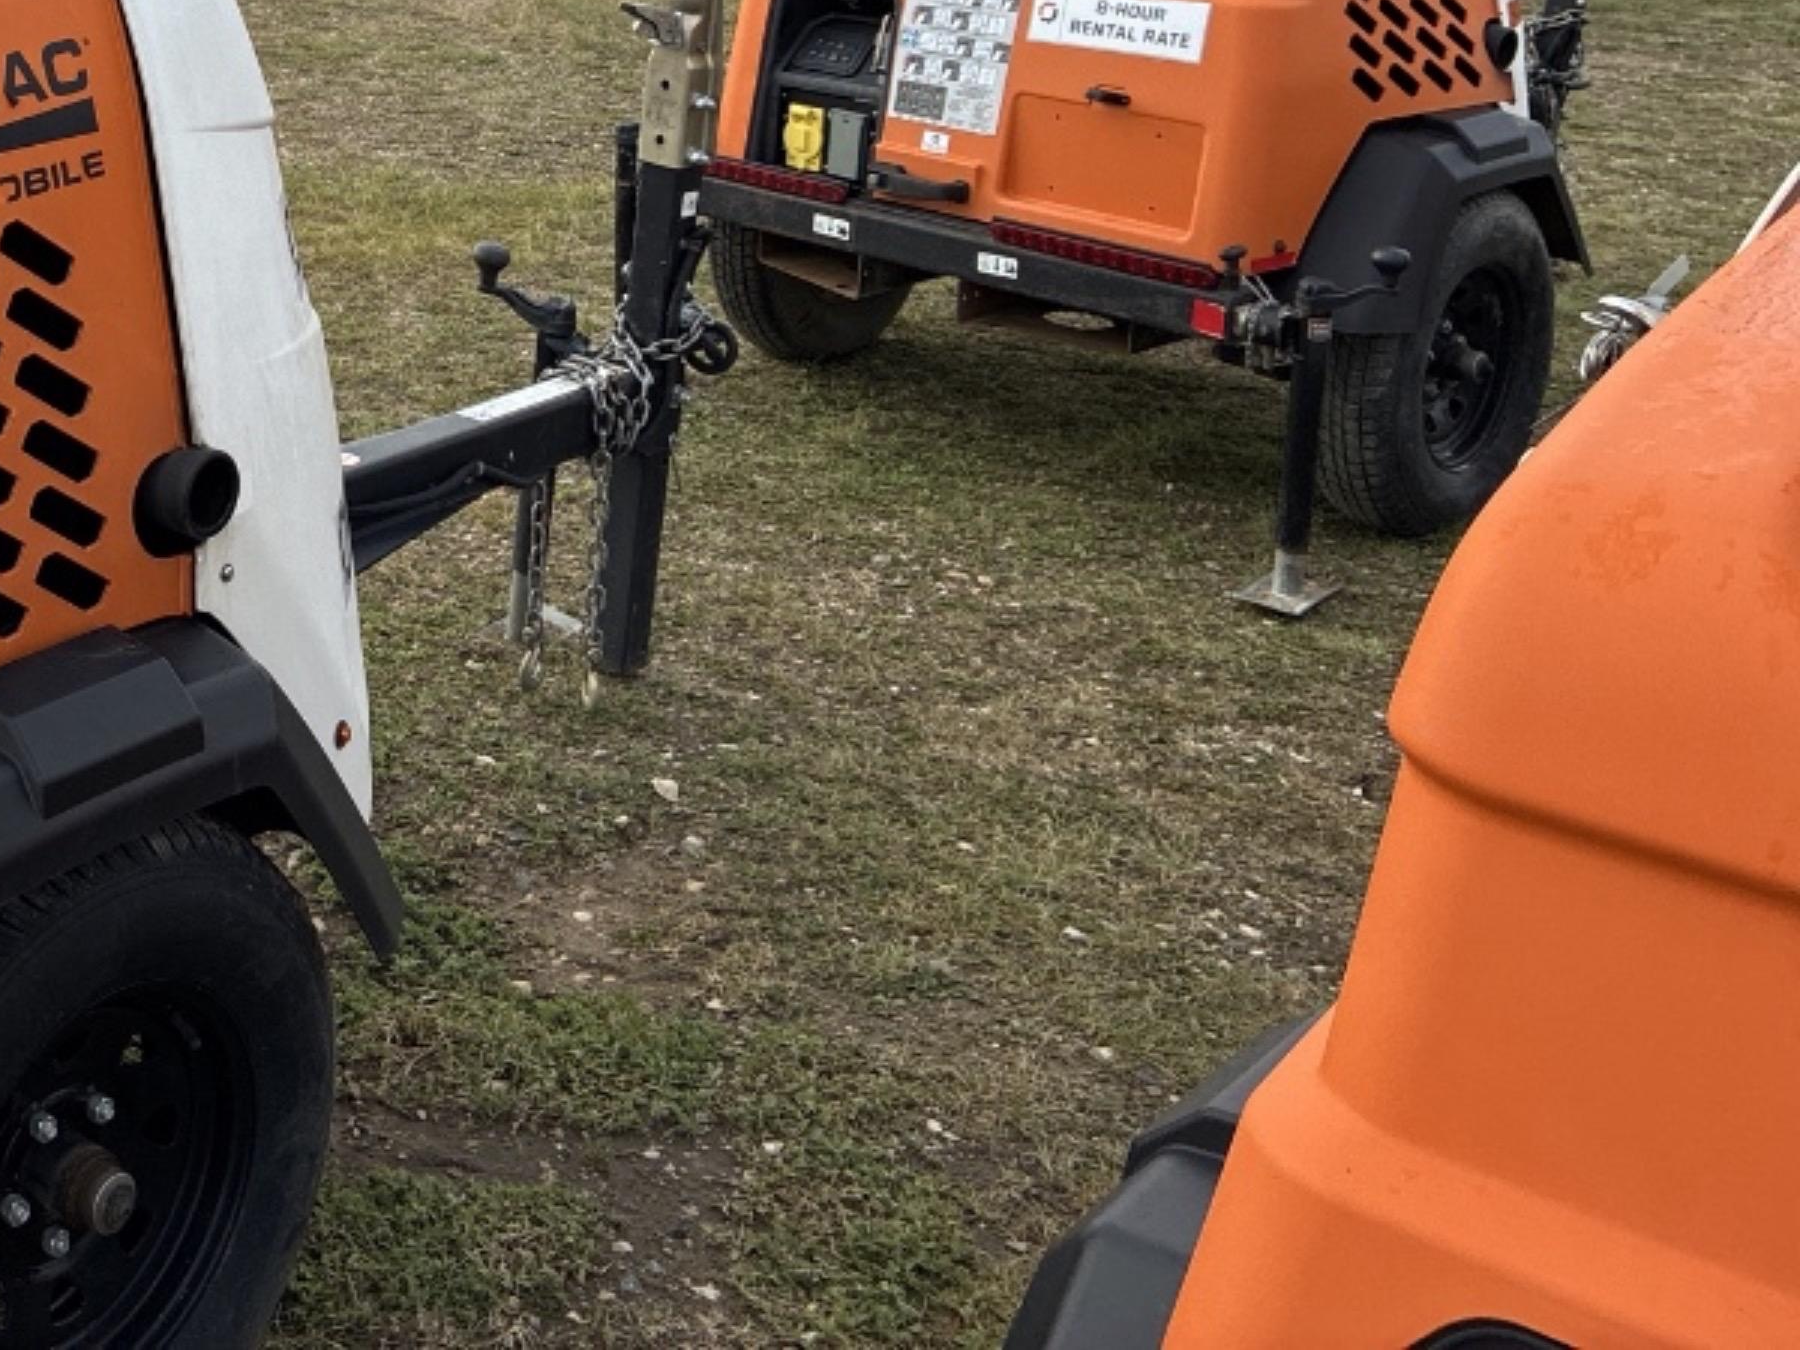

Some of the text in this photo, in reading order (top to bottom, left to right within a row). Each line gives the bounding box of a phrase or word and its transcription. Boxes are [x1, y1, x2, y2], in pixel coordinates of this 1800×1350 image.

[1095, 0, 1167, 22] 8-HOUR
[1068, 19, 1192, 49] RENTAL RATE
